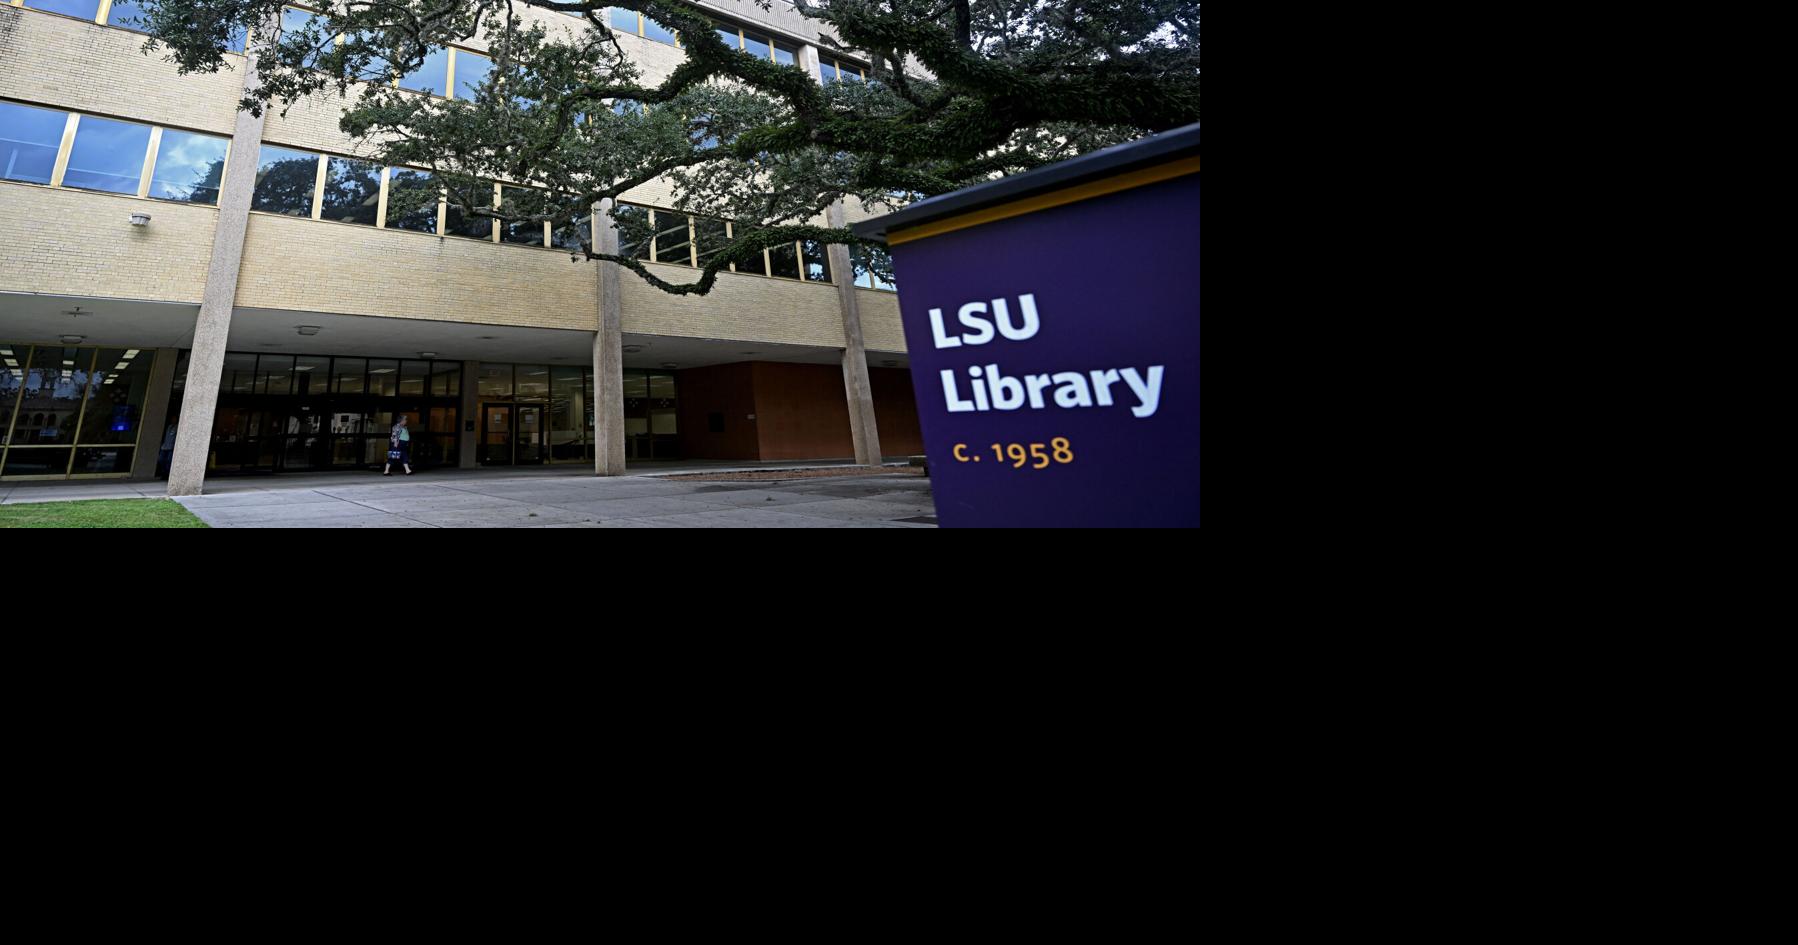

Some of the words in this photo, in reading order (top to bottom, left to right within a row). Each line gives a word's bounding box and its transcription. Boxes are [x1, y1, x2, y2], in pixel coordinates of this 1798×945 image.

[928, 293, 1040, 349] LSU
[940, 363, 1164, 418] Library
[953, 443, 980, 462] c.
[991, 437, 1074, 469] 1958
